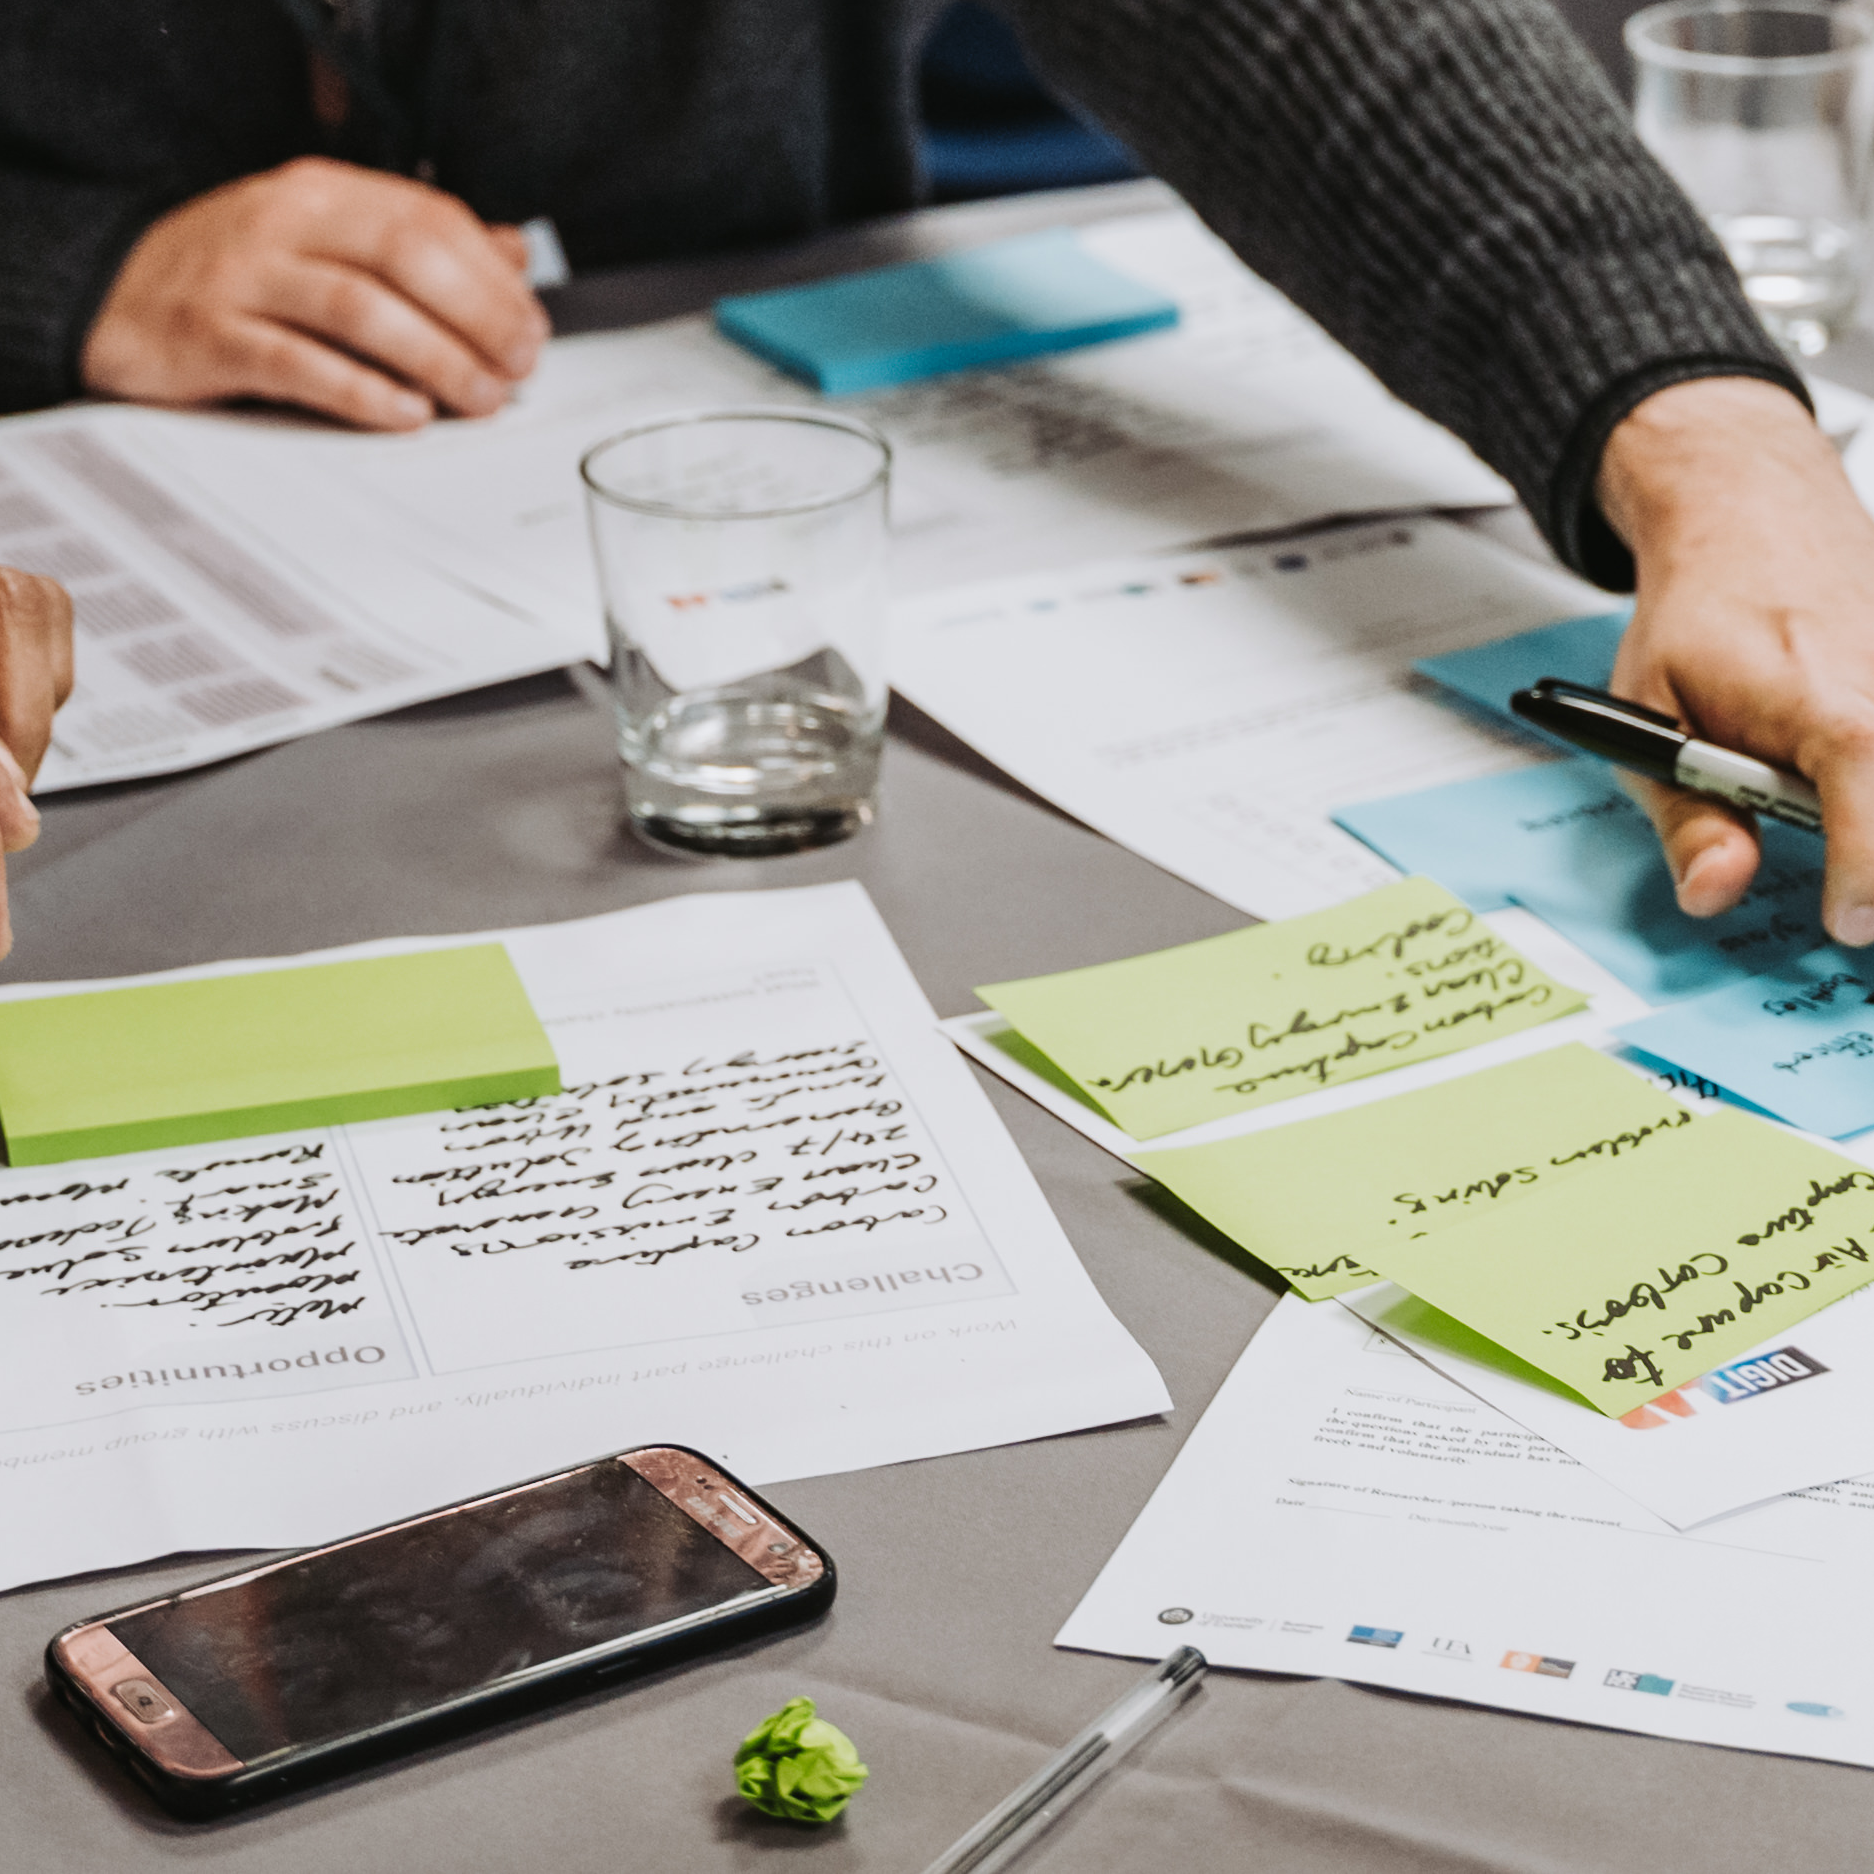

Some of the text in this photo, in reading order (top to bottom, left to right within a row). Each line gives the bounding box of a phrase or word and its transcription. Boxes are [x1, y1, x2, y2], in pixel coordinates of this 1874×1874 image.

[1424, 957, 1526, 1000] Clean
[1424, 984, 1553, 1032] Carbon
[785, 1124, 909, 1157] 24/7
[450, 1175, 938, 1257] Carbon Emissions
[785, 1205, 948, 1238] Carbon
[1810, 1237, 1870, 1274] Air
[740, 1261, 984, 1309] Challenges
[843, 1333, 892, 1354] this
[903, 1327, 937, 1343] on
[947, 1317, 1018, 1340] Work
[73, 1344, 386, 1398] Opportunities
[630, 1360, 688, 1384] part
[698, 1343, 833, 1374] challenge
[454, 1372, 621, 1410] individually,
[1707, 1351, 1813, 1400] DIGIT
[269, 1408, 380, 1436] discuss
[388, 1399, 443, 1421] and
[103, 1425, 188, 1453] group
[197, 1423, 260, 1442] with
